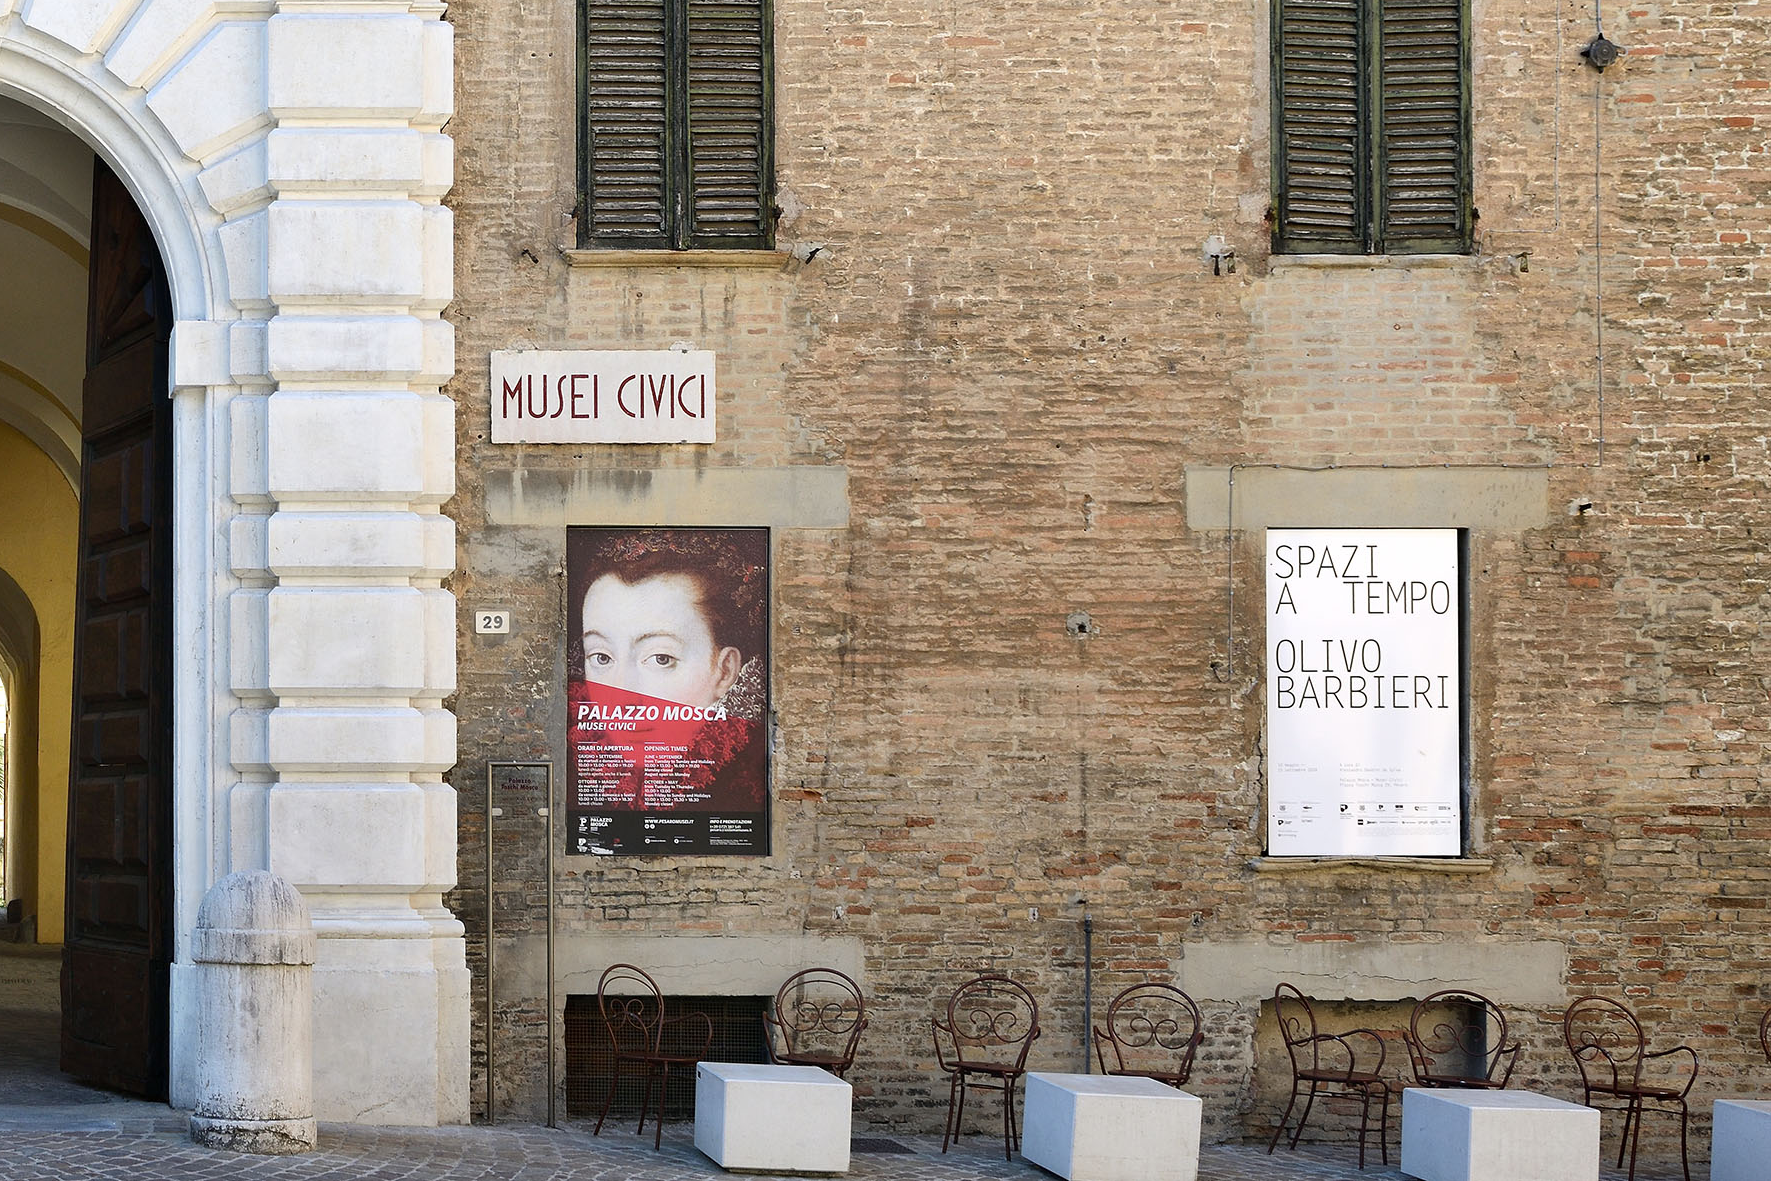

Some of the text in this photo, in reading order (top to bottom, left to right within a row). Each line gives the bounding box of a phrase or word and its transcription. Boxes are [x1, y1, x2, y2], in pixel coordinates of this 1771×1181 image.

[502, 374, 706, 419] MUSEI CIVICI
[1275, 545, 1378, 579] SPAZI
[1275, 581, 1450, 614] A TEMPO
[483, 616, 503, 629] 29
[1276, 639, 1381, 673] OLIVO
[1277, 675, 1449, 709] BARBIERI
[577, 722, 636, 731] MUSEI CIVICI
[578, 705, 726, 721] PALAZZO MOSCA
